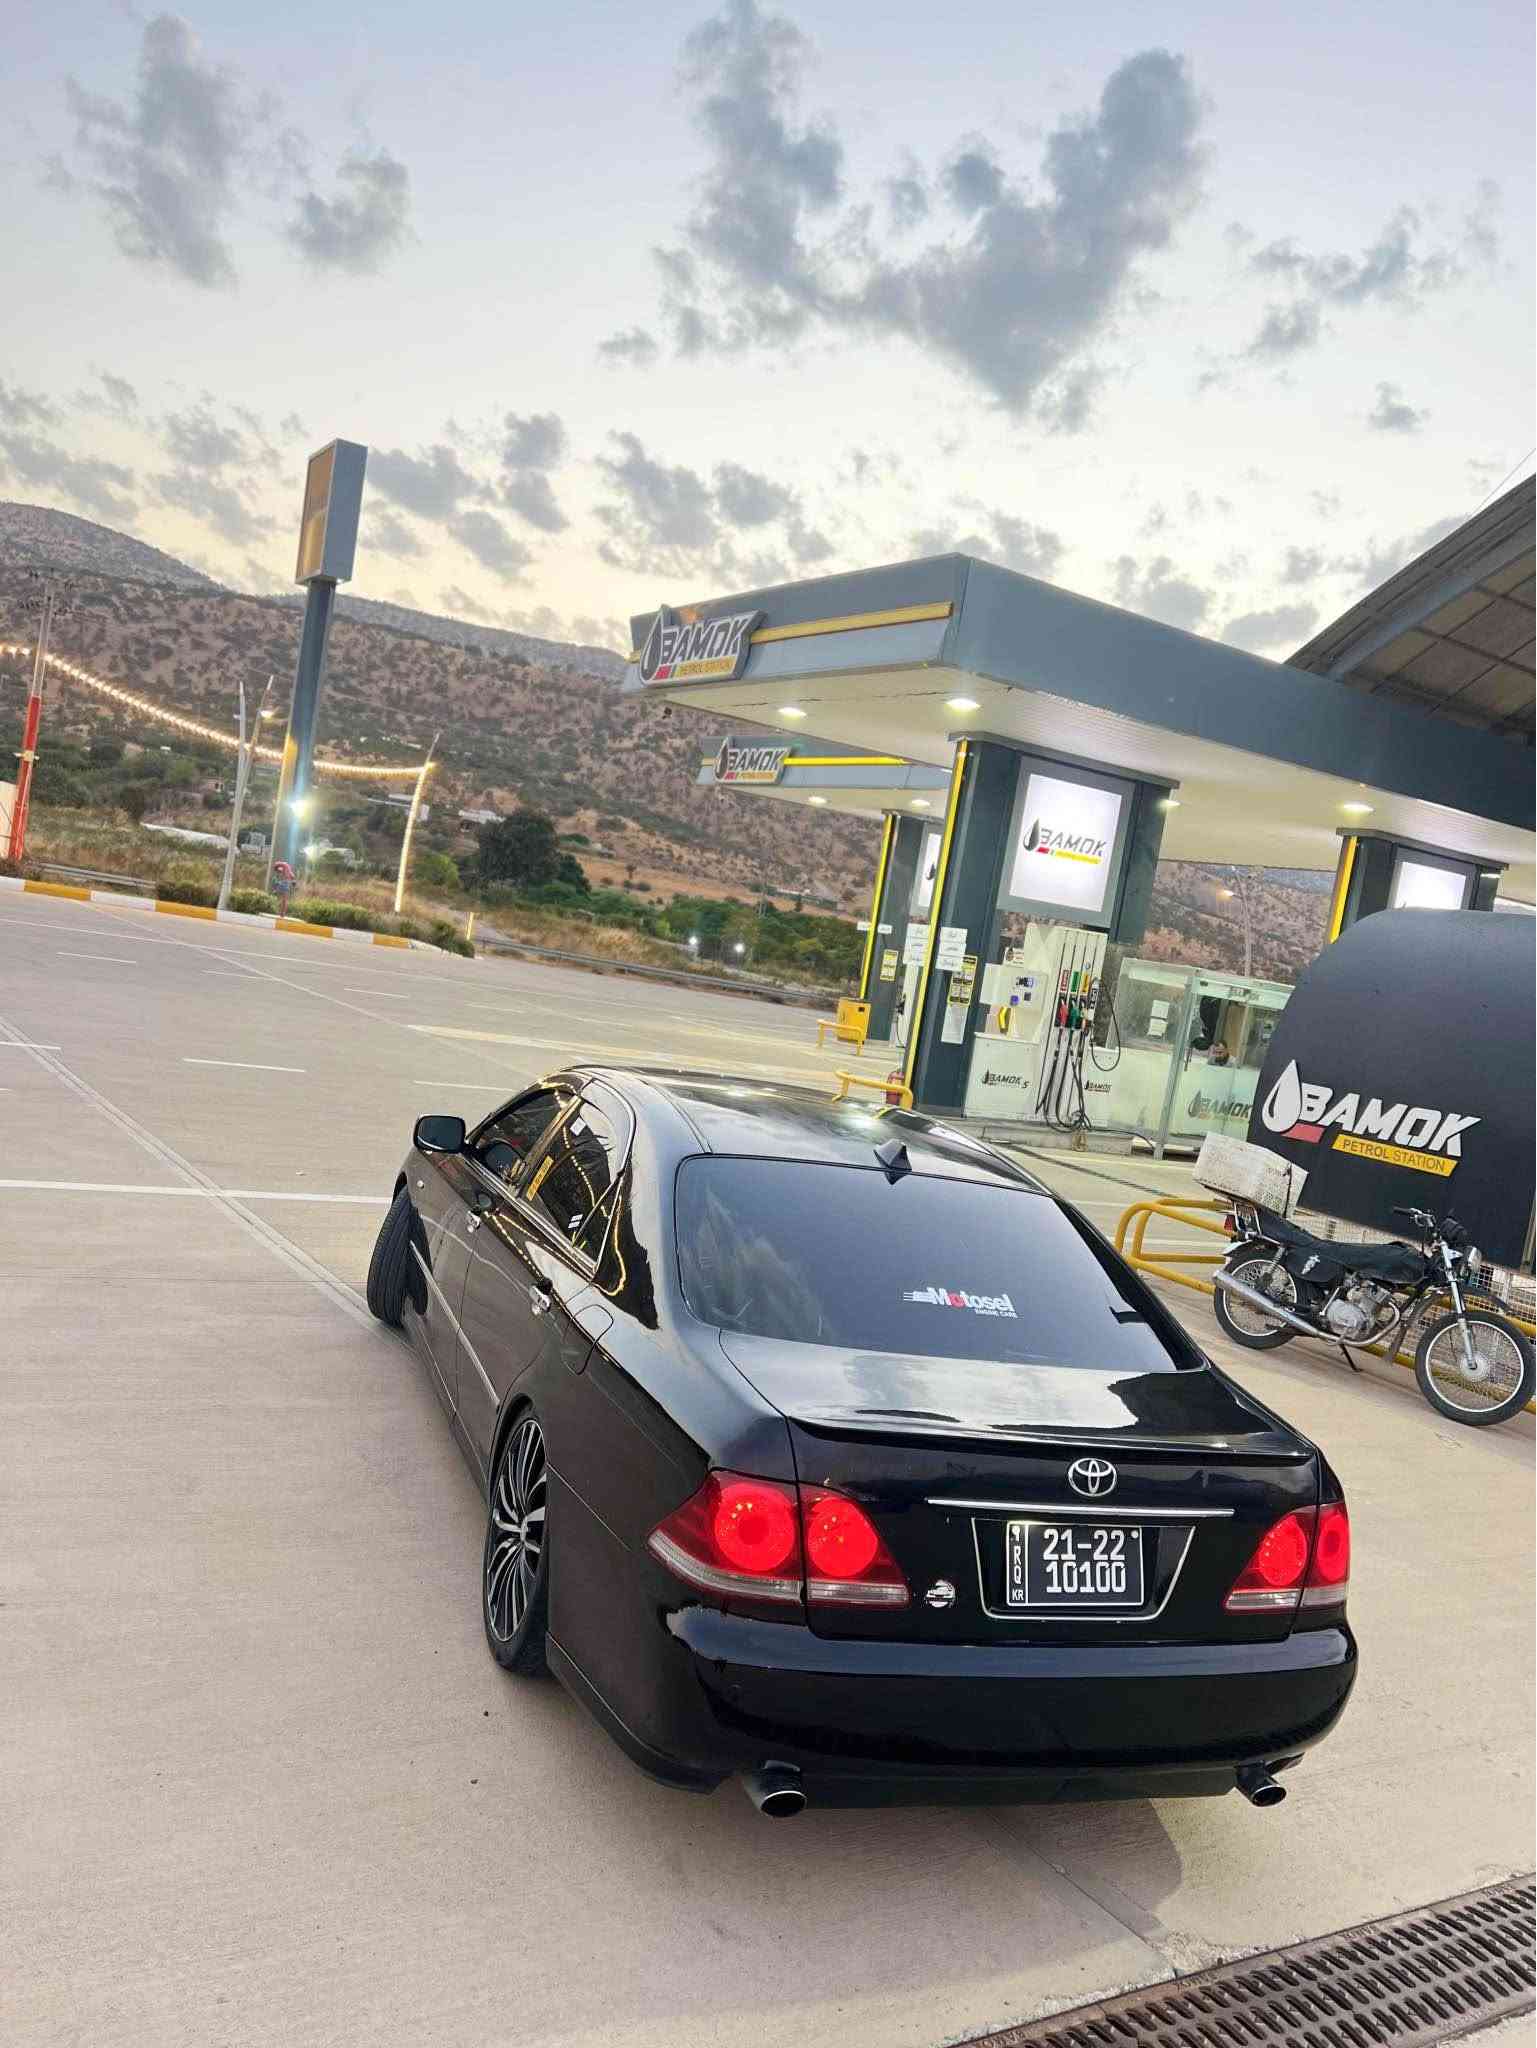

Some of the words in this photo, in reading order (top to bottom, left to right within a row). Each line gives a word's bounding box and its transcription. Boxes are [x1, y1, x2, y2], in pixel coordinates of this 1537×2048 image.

[661, 613, 753, 664] BAMOK
[728, 748, 786, 771] BAMOK
[1040, 827, 1107, 857] BAMOK
[1200, 1096, 1254, 1120] BAMOK
[1299, 1081, 1482, 1157] BAMOK
[1342, 1138, 1390, 1160] PETROL
[1391, 1149, 1446, 1172] STATION
[925, 1286, 1016, 1313] Motosel
[1042, 1528, 1126, 1561] 21-22
[1045, 1561, 1126, 1593] 10100
[1011, 1588, 1025, 1602] KR
